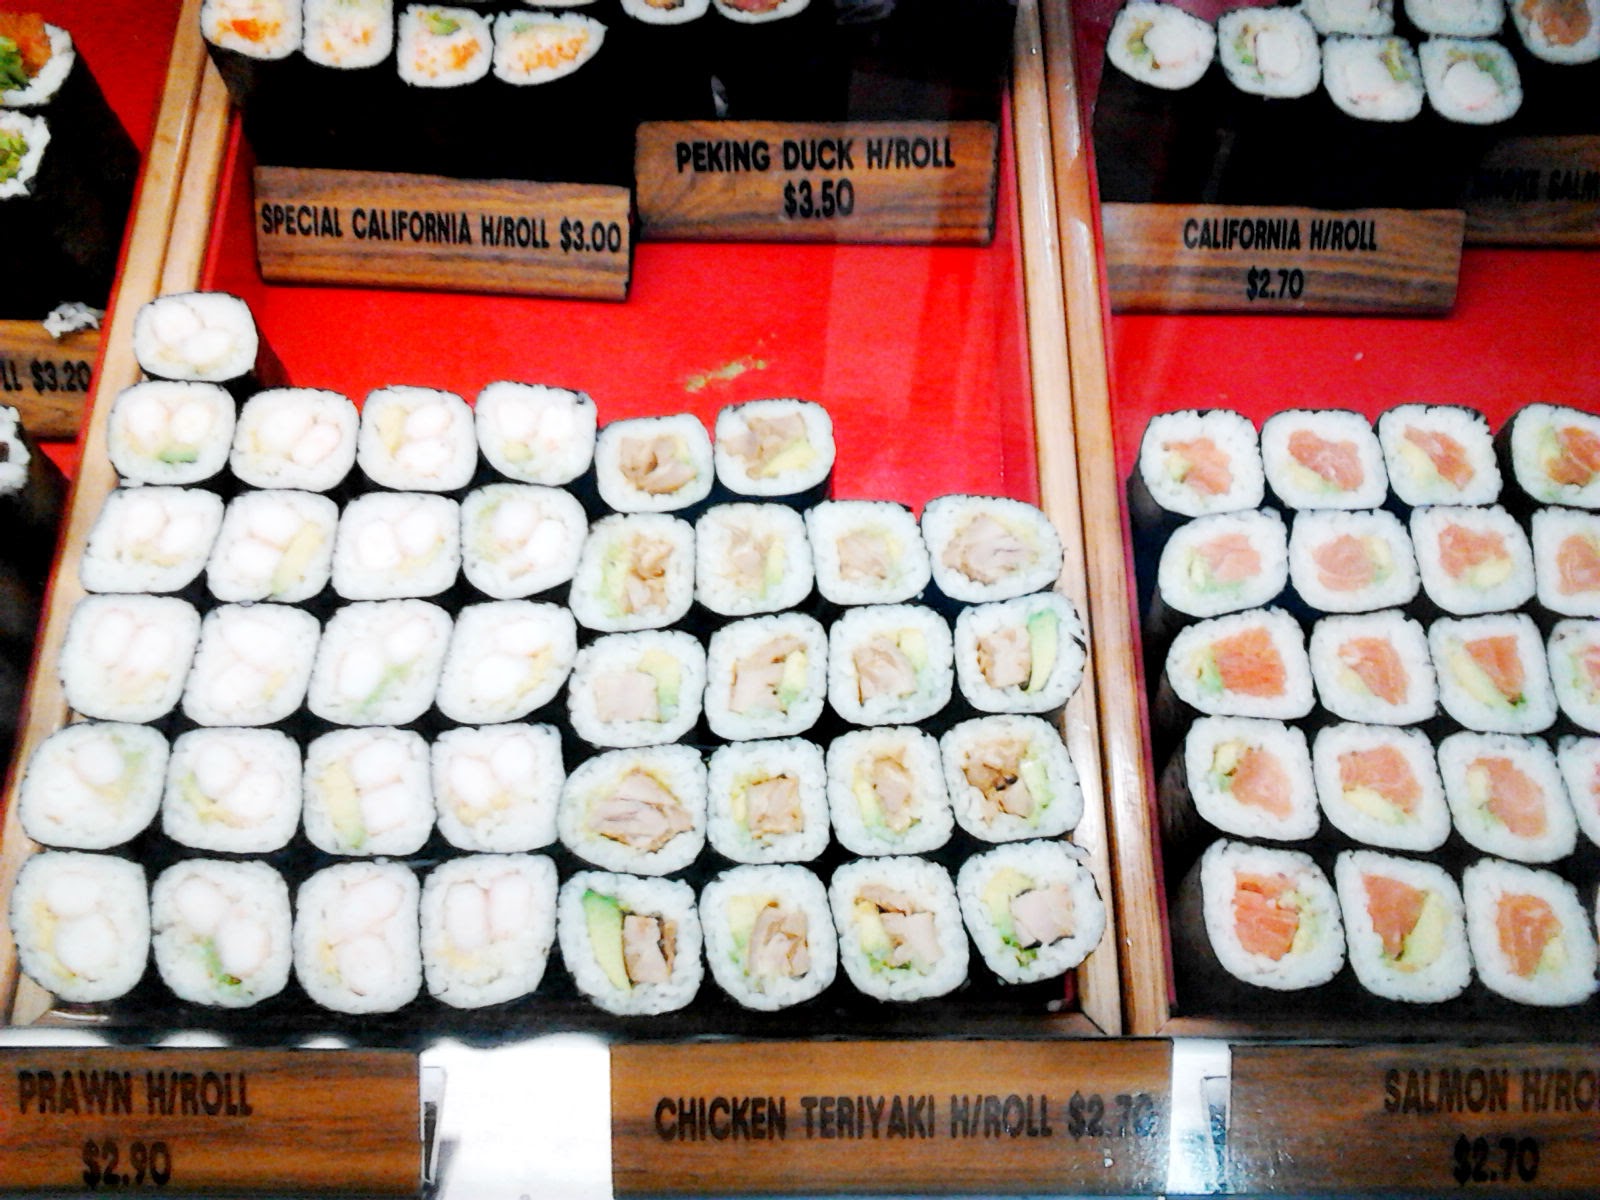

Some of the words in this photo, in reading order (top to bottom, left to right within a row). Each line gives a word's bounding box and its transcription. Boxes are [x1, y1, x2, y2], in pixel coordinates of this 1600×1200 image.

[675, 141, 771, 172] PEKING
[783, 138, 854, 170] DUCK
[866, 136, 956, 169] H/ROLL
[784, 179, 854, 218] $3.50
[261, 202, 343, 238] SPECIAL
[352, 208, 472, 245] CALIFORNIA
[481, 213, 549, 249] H/ROLL
[559, 216, 622, 254] $3.00
[1183, 217, 1301, 250] CALIFORNIA
[1309, 219, 1378, 251] H/ROLL
[1246, 265, 1305, 302] $2.70
[30, 357, 92, 395] $3.20
[17, 1069, 133, 1115] PRAWN
[145, 1071, 254, 1117] H/ROLL
[1384, 1067, 1509, 1114] SALMON
[1521, 1067, 1600, 1112] H/RO
[653, 1096, 787, 1141] CHICKEN
[799, 1095, 935, 1140] TERIYAKI
[950, 1094, 1053, 1138] H/ROLL
[82, 1138, 172, 1188] $2.90
[1453, 1133, 1540, 1186] $2.70
